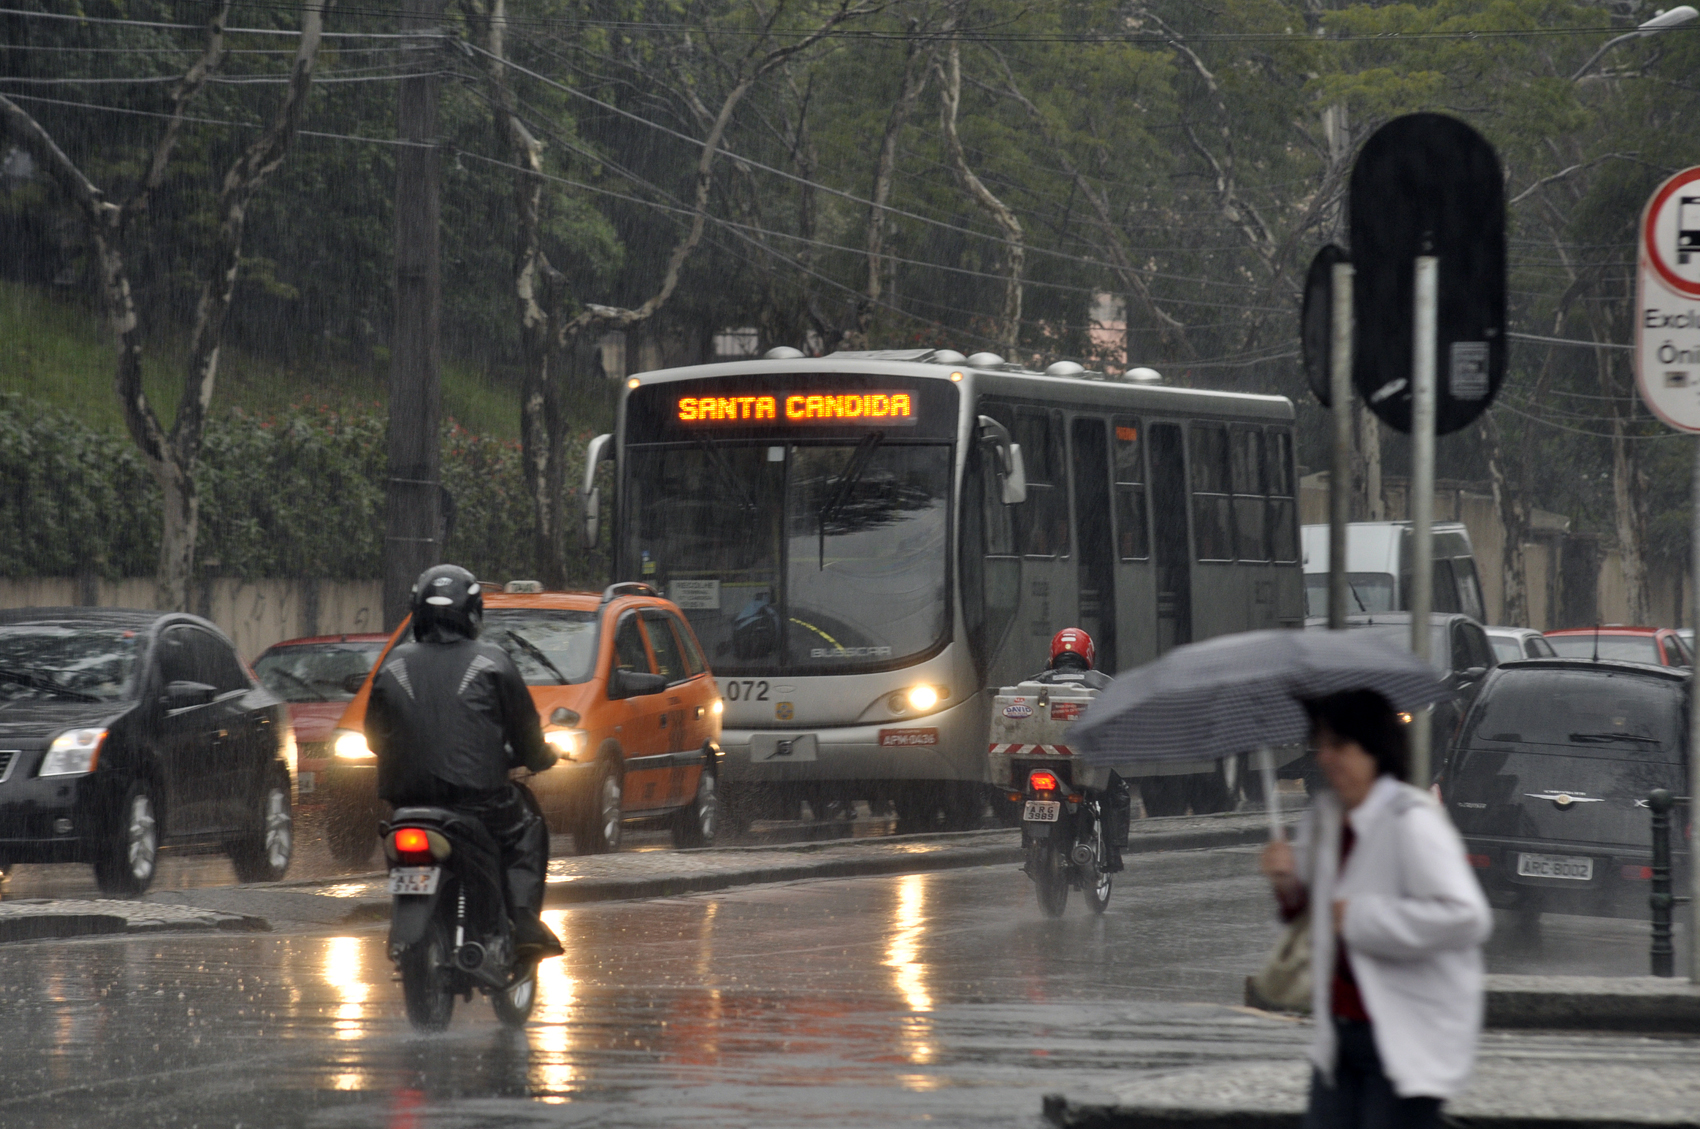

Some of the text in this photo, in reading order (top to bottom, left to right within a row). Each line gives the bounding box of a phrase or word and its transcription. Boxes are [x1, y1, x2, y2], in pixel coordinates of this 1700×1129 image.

[678, 394, 910, 420] SANTA CANDIDA
[810, 646, 892, 658] BUSSCAR
